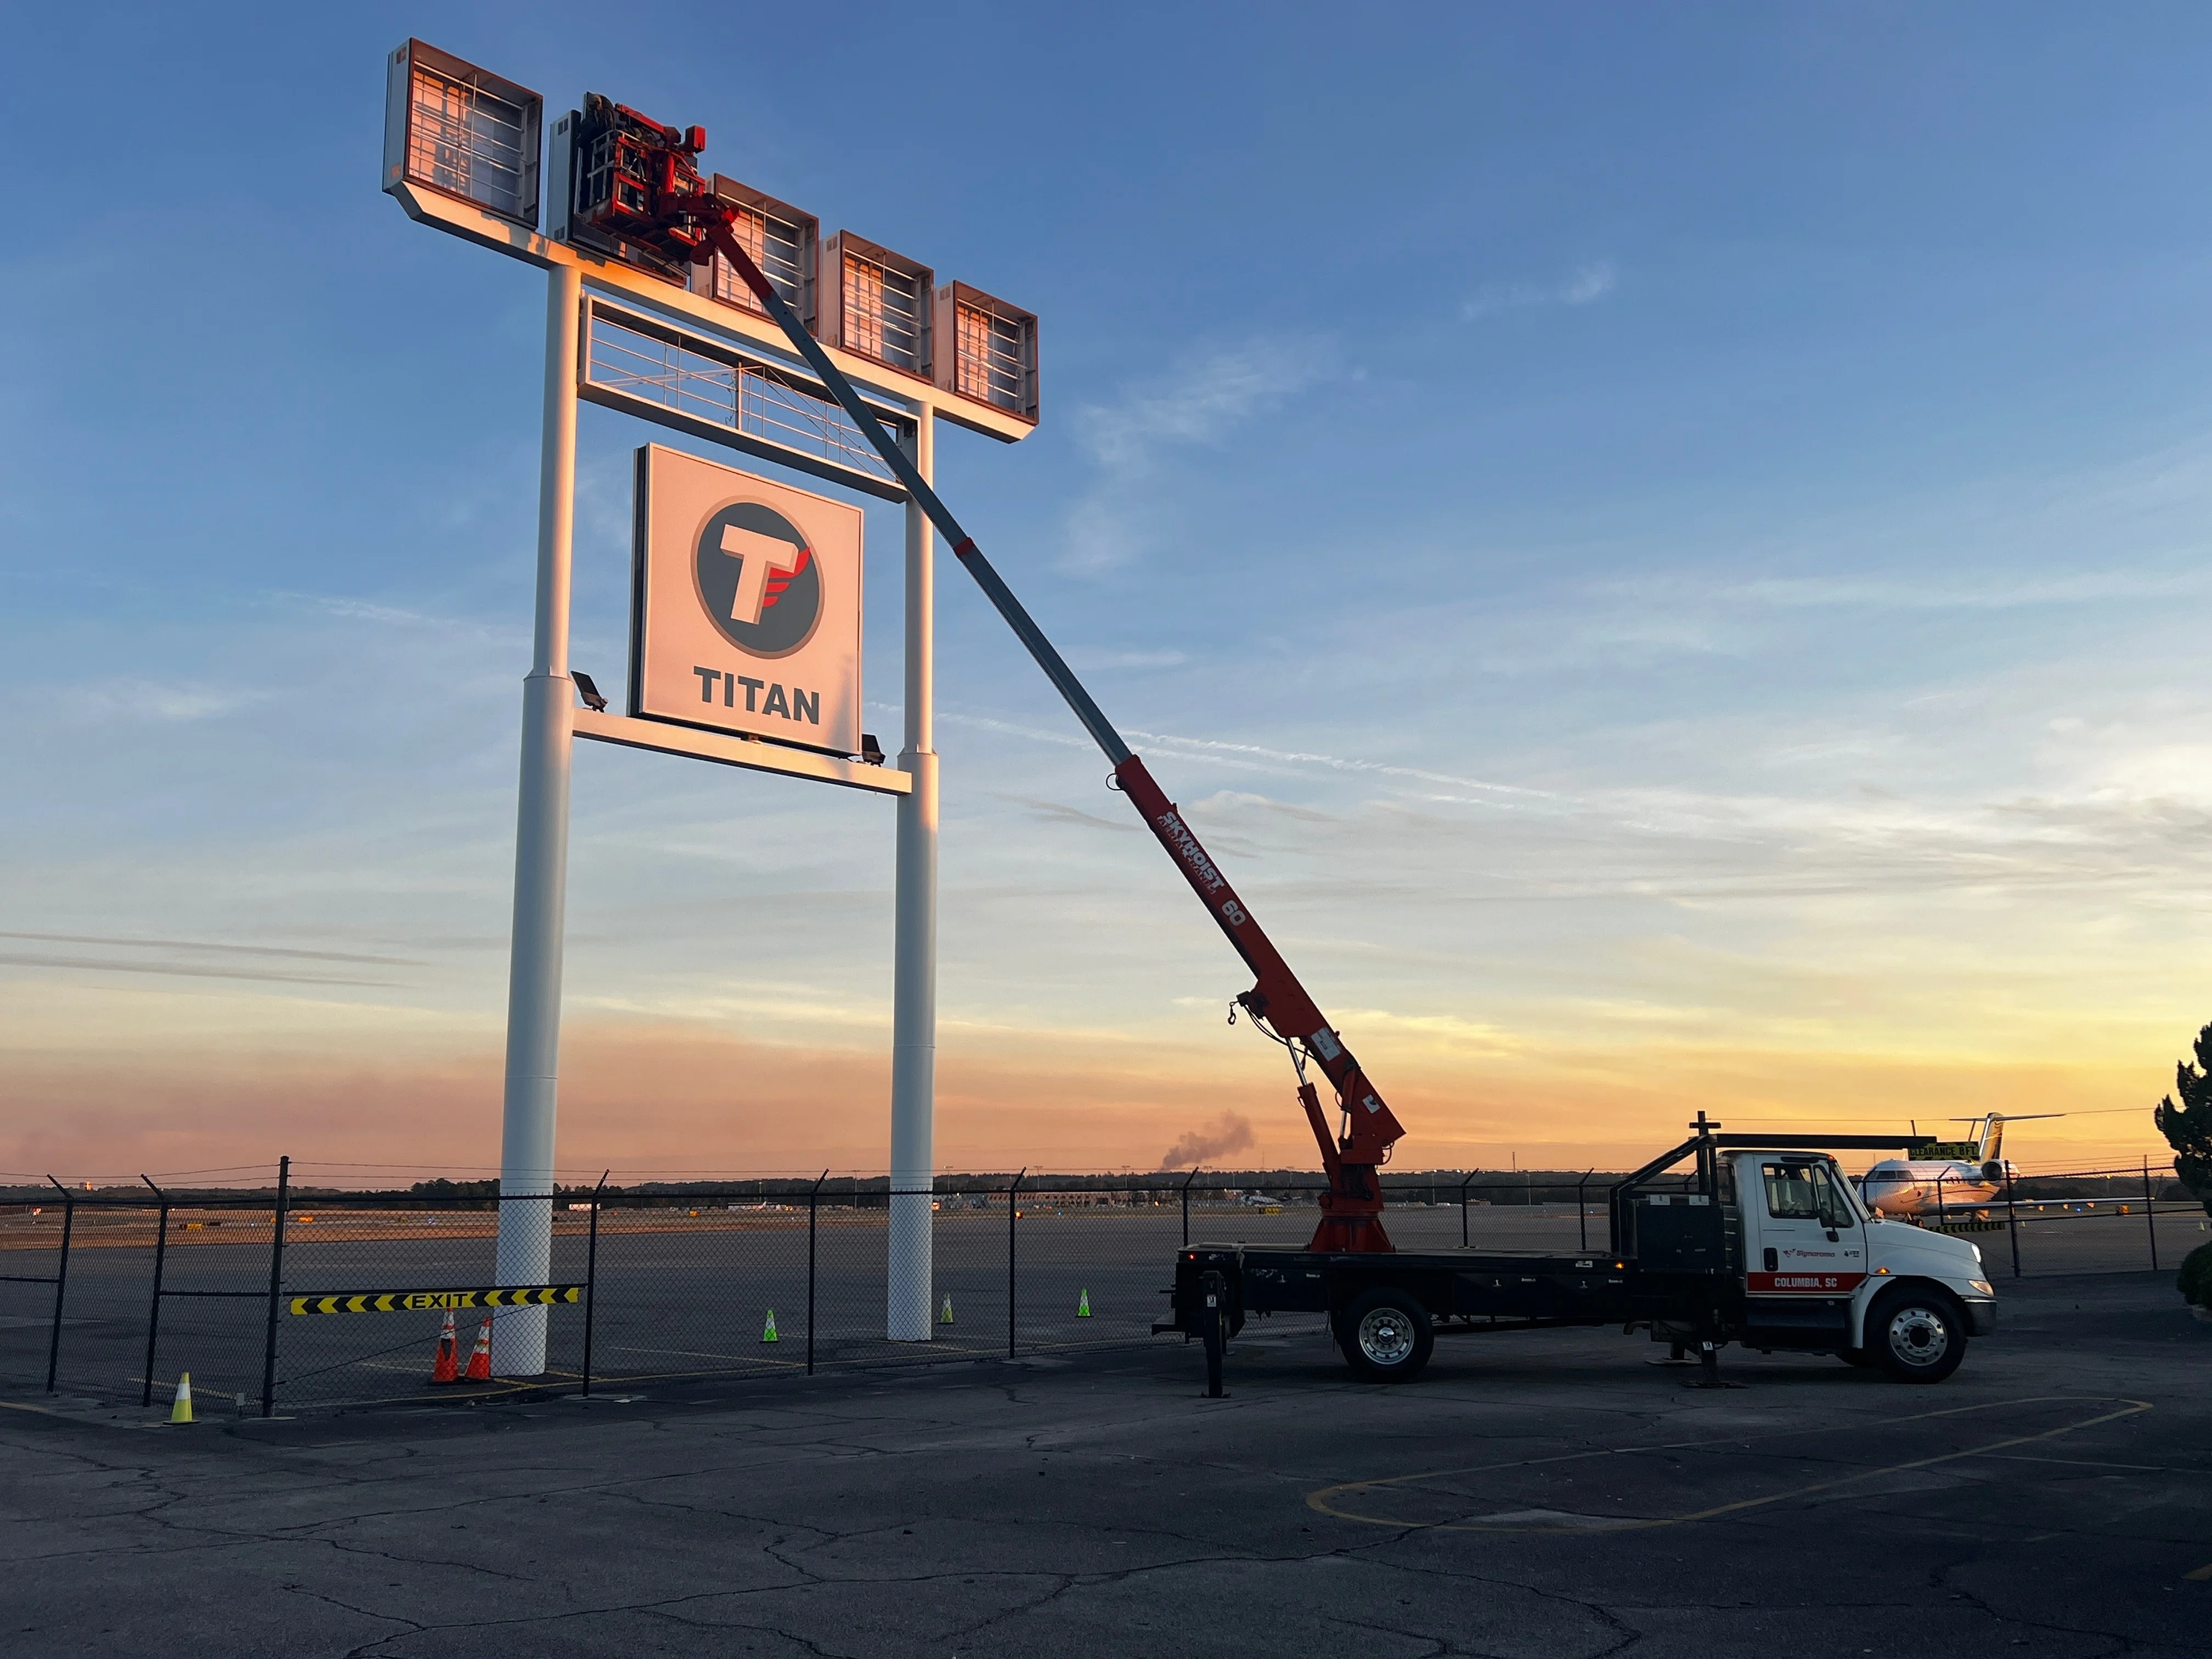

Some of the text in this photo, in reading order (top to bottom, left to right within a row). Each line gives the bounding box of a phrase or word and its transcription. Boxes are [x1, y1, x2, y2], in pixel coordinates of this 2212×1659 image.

[693, 665, 820, 725] TITAN
[1162, 811, 1246, 927] SKYHOIST 60
[1910, 1147, 1956, 1156] CLEARANCE
[1959, 1146, 1965, 1155] 8
[1796, 1250, 1836, 1258] Signarama
[1774, 1277, 1837, 1289] COLUMBIA, SC
[411, 1293, 468, 1308] EXIT
